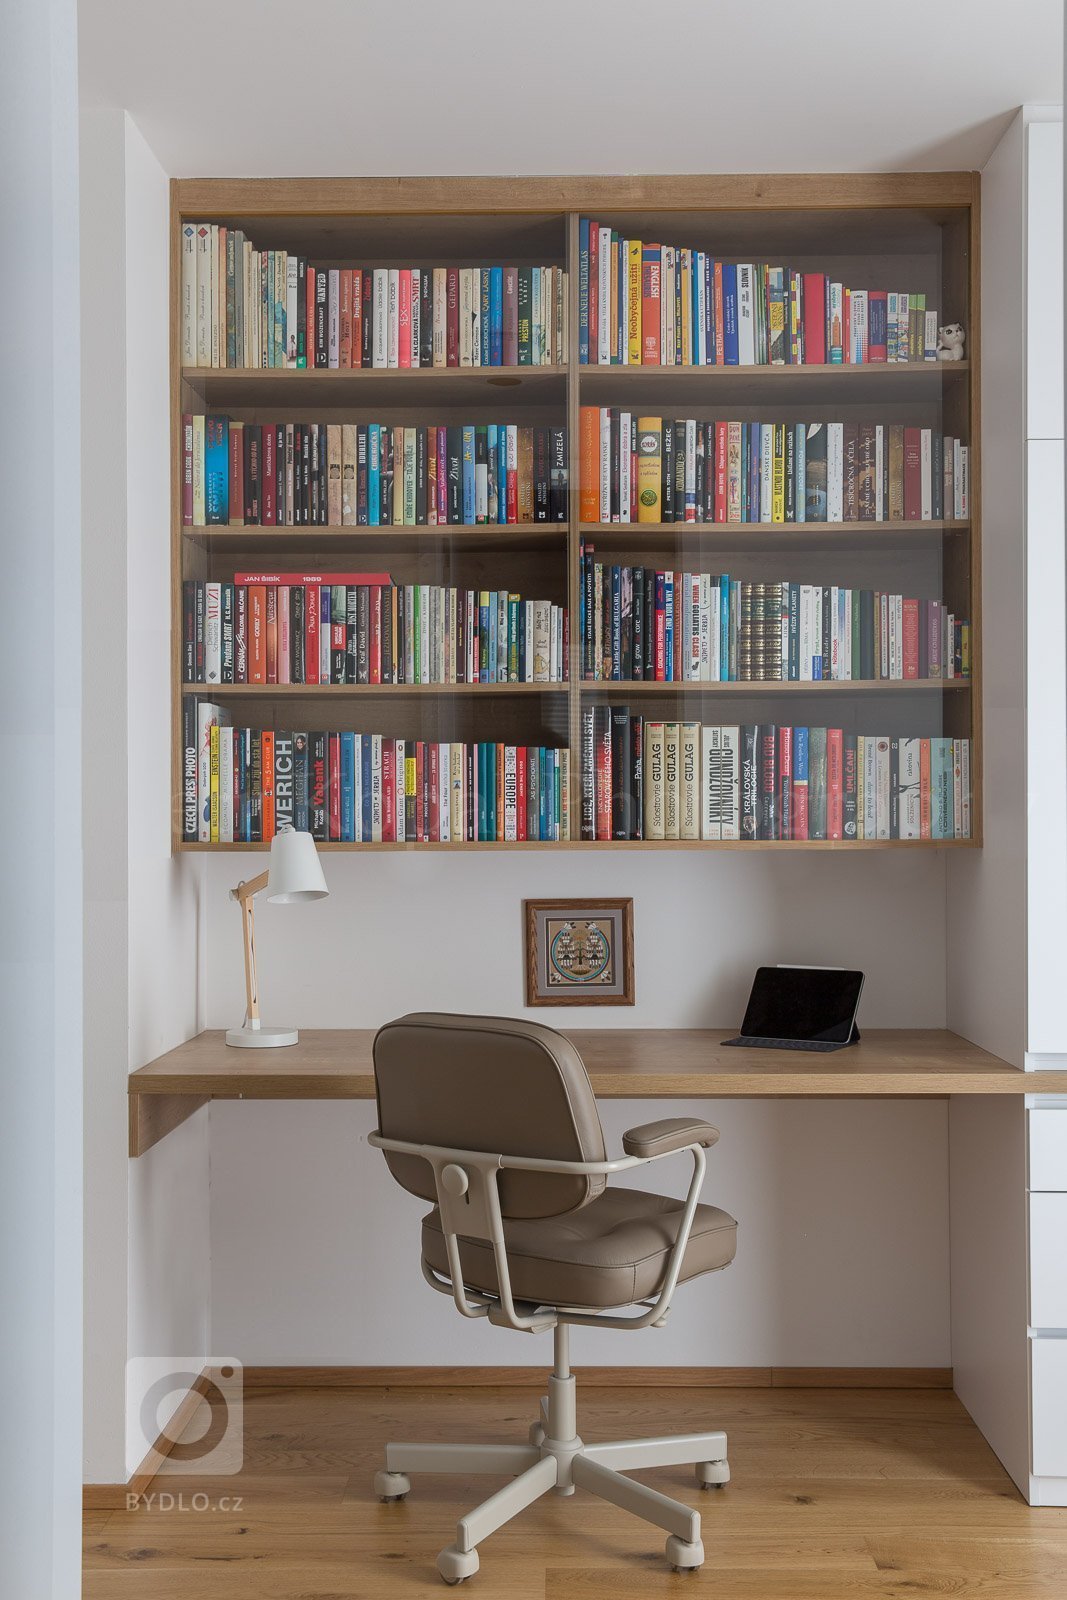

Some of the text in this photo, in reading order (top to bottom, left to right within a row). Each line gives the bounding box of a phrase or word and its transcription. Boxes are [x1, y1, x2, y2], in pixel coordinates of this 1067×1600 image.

[317, 273, 326, 303] WANTED
[651, 266, 659, 298] ENGLISH
[400, 309, 408, 326] SEX
[630, 287, 638, 340] Neobyčejná
[449, 456, 458, 480] Život
[555, 432, 564, 467] ZMIZELÁ
[314, 760, 324, 805] Vabank
[583, 713, 593, 820] LIDÉ, KTEŘÍ ZMĚNILI SVĚT
[652, 743, 661, 781] GULAG
[763, 736, 775, 793] BAD BLOOD
[845, 749, 854, 793] UMLČANÍ
[186, 748, 196, 833] CZECH PRESS PHOTO
[275, 740, 292, 832] WERICH
[506, 773, 515, 809] EUROPE
[667, 743, 676, 826] Súostrovie GULAG
[685, 743, 693, 826] Súostrovie GULAG
